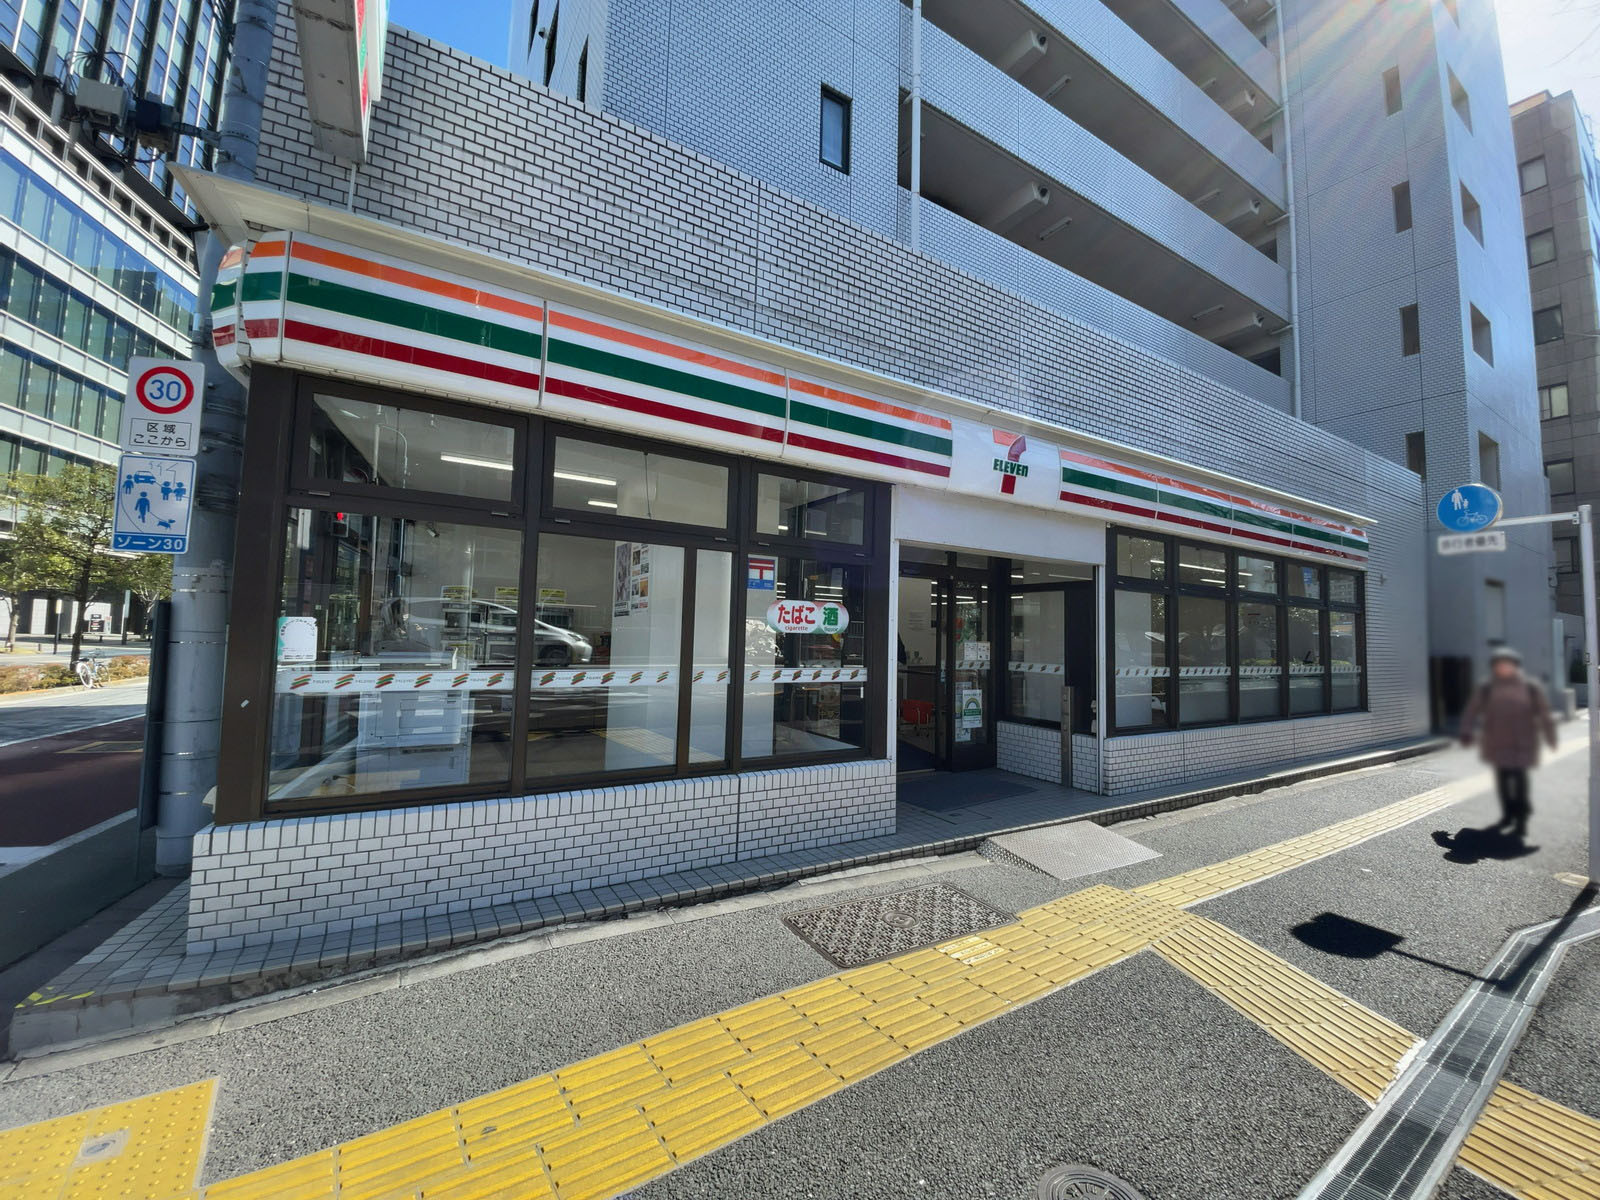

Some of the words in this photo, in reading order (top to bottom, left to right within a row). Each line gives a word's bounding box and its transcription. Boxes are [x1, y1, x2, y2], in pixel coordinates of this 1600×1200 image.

[149, 379, 182, 402] 30
[147, 422, 176, 434] 区域
[133, 433, 187, 448] ここから
[118, 536, 183, 551] ゾーン30
[777, 604, 816, 625] たばこ
[822, 606, 839, 626] 酒
